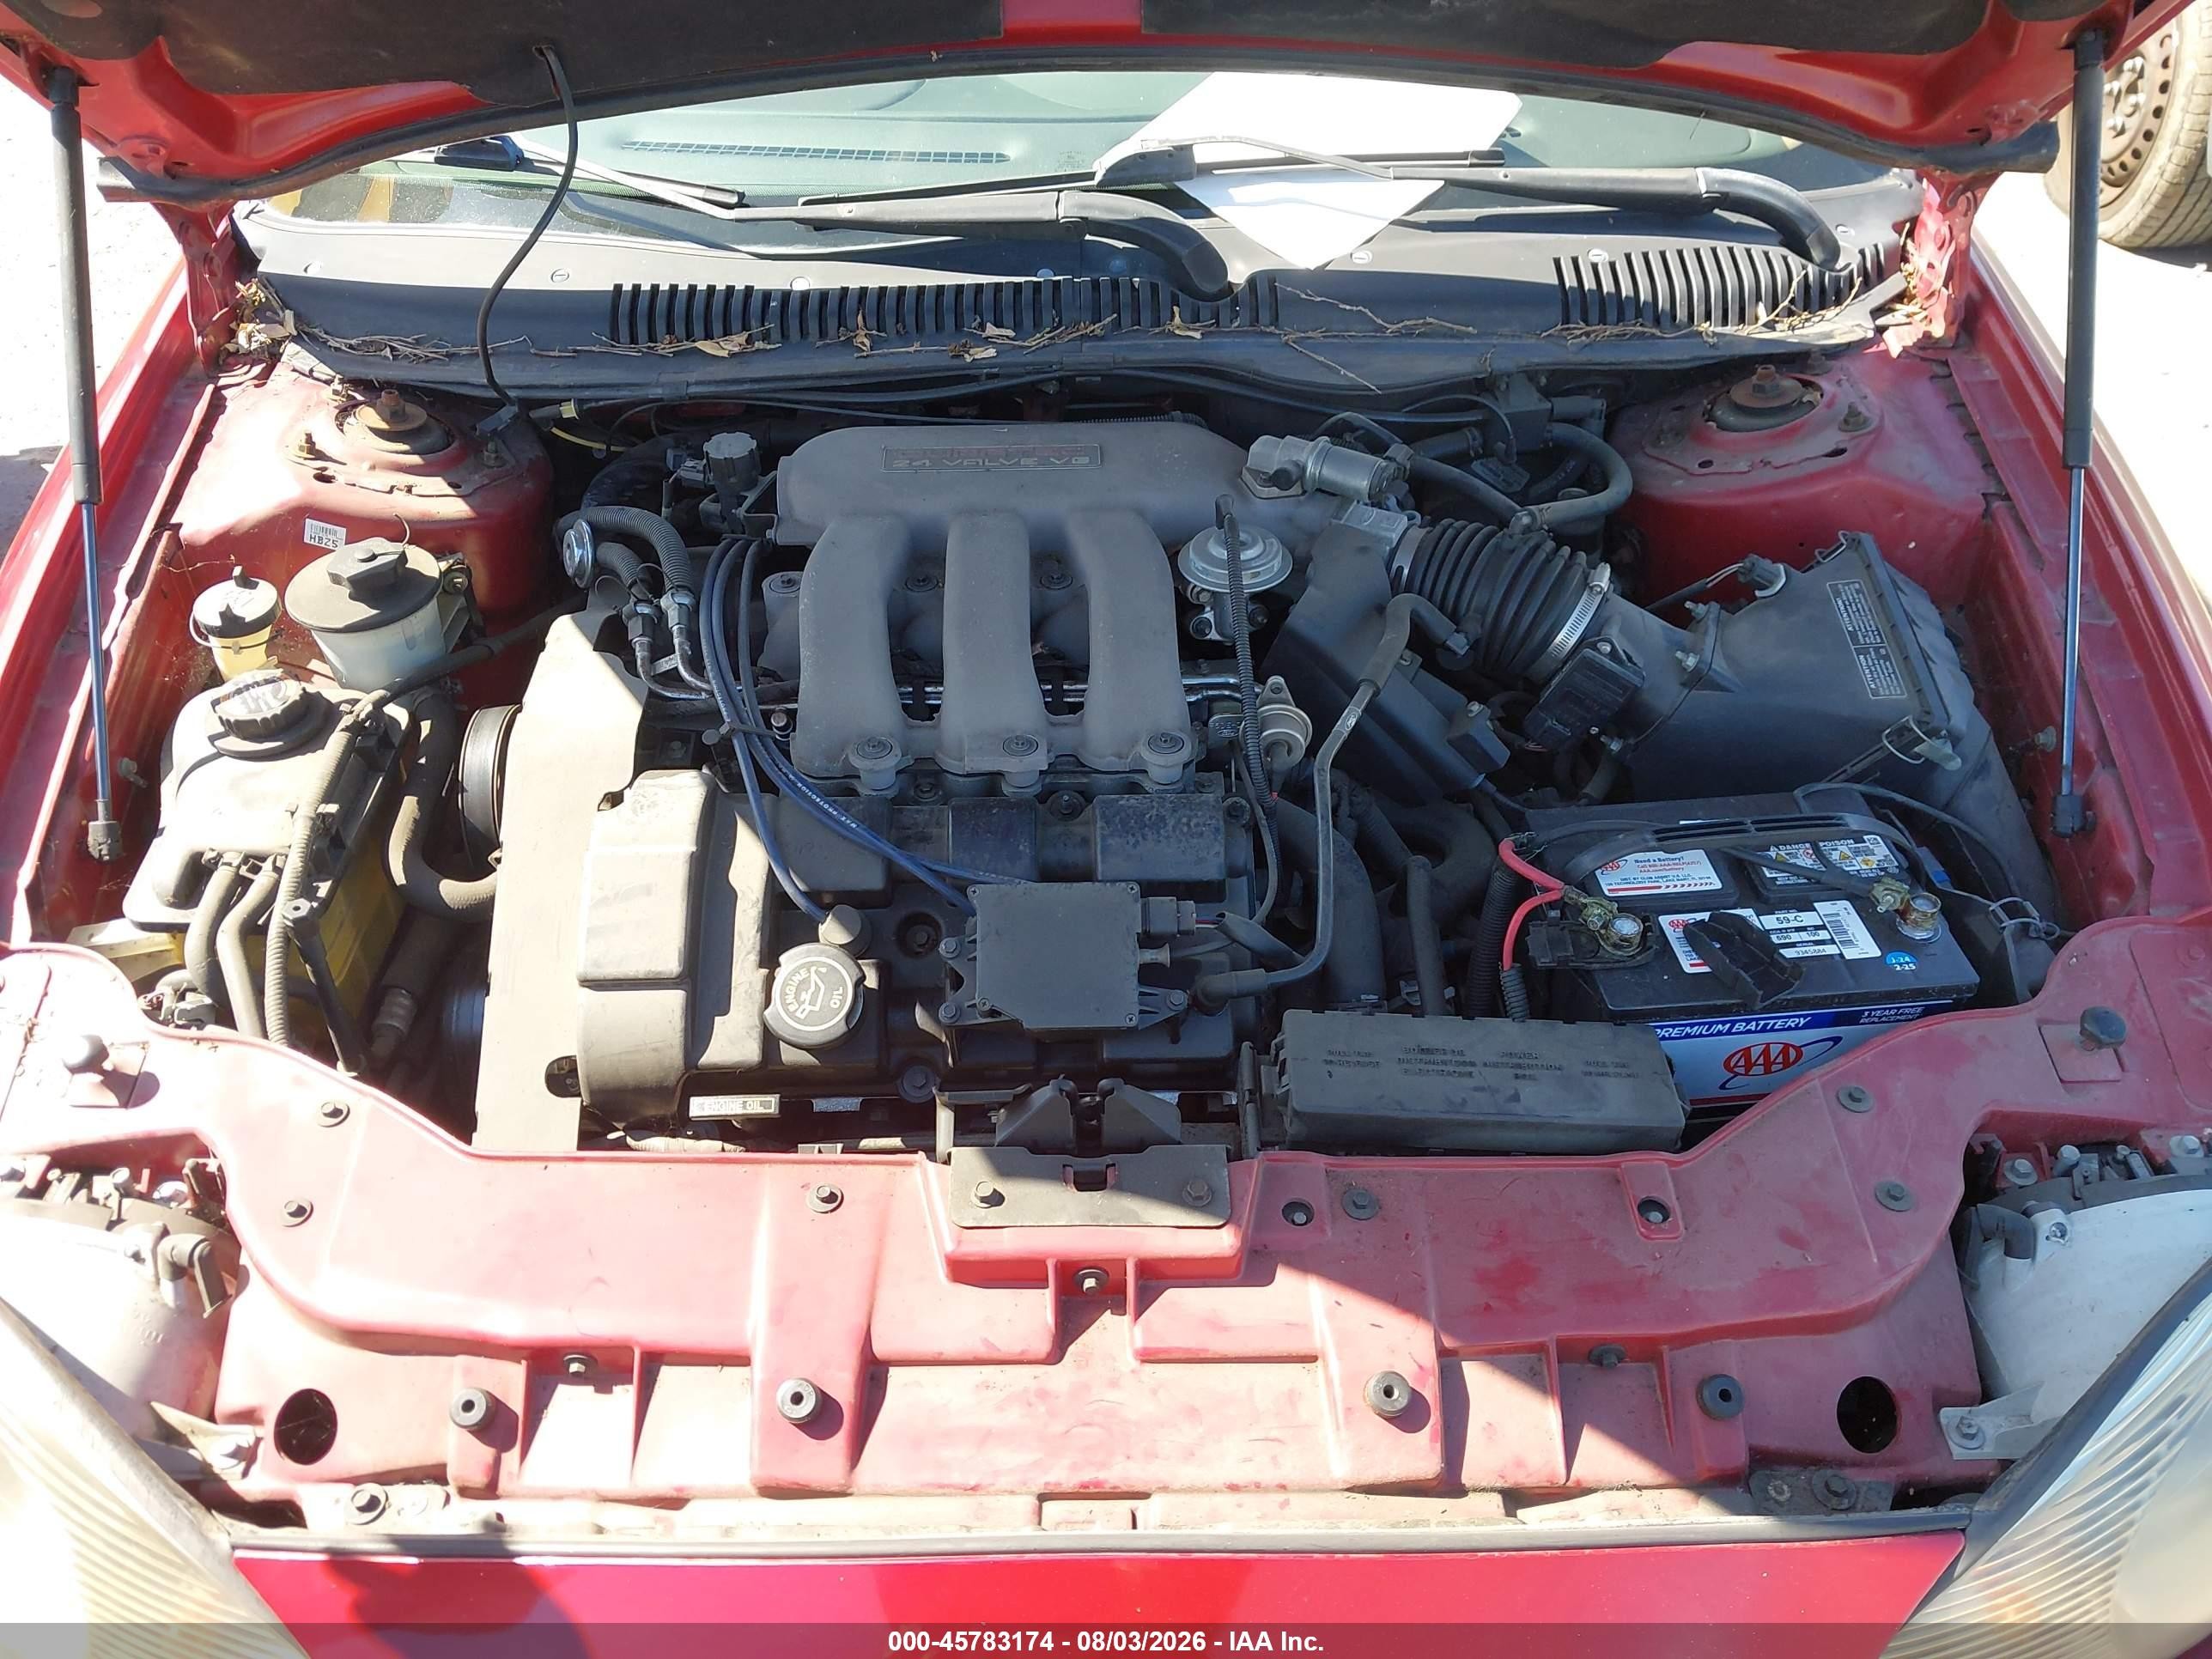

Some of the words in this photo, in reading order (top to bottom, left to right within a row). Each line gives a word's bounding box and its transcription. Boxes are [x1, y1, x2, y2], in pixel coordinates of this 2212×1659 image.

[892, 459, 933, 468] 24
[943, 457, 1039, 467] VALVE
[1778, 842, 1812, 851] DANGE
[1818, 838, 1855, 848] POISON
[1776, 915, 1803, 925] 59-C
[1893, 963, 1917, 971] 2-25
[785, 967, 811, 1012] ENGINE
[830, 986, 843, 1009] OIL
[1731, 1017, 1812, 1033] BATTERY
[1728, 1042, 1799, 1076] AAA
[706, 1100, 744, 1111] ENGINE
[746, 1099, 764, 1110] OIL
